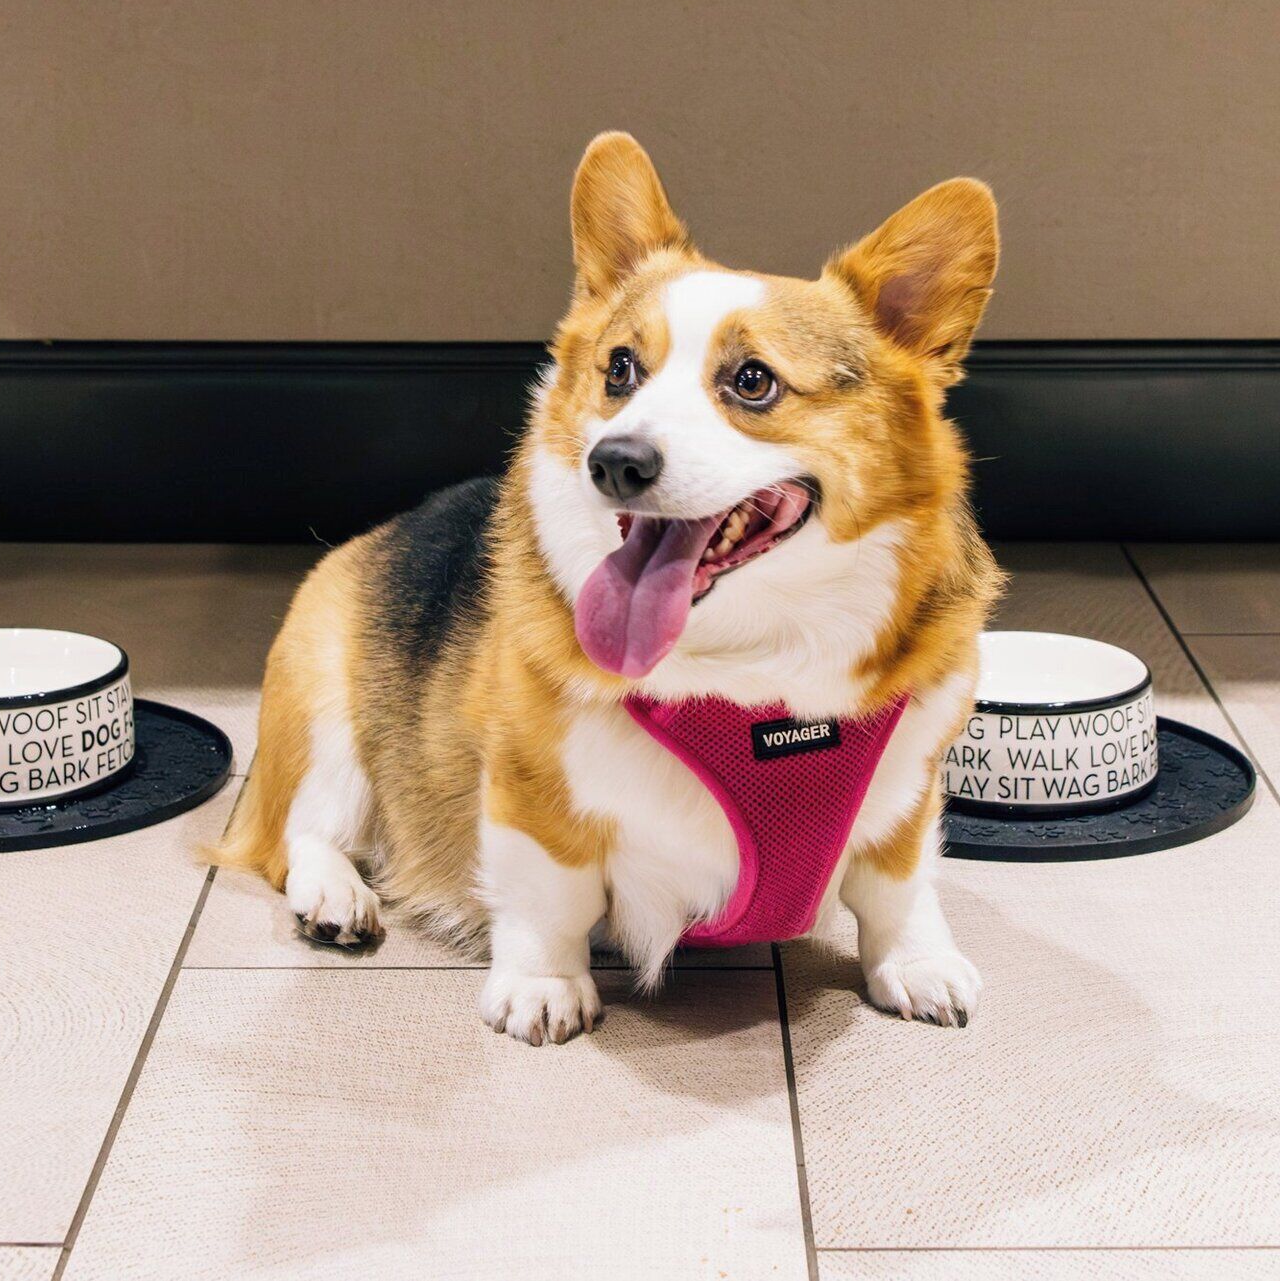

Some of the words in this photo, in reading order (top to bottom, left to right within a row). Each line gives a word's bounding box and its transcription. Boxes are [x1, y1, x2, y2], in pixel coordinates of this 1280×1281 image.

[76, 695, 102, 725] SIT
[999, 716, 1061, 741] PLAY
[1069, 705, 1133, 739] WOOF
[9, 734, 74, 766] LOVE
[81, 718, 121, 753] DOG
[763, 723, 831, 748] VOYAGER
[941, 744, 992, 772] ARK
[1007, 746, 1080, 772] WALK
[1090, 734, 1138, 768] LOVE
[1142, 724, 1158, 753] DO
[28, 757, 91, 792] BARK
[940, 770, 990, 800] LAY
[997, 776, 1036, 800] SIT
[1041, 773, 1100, 800] WAG
[1107, 758, 1148, 794] BARK
